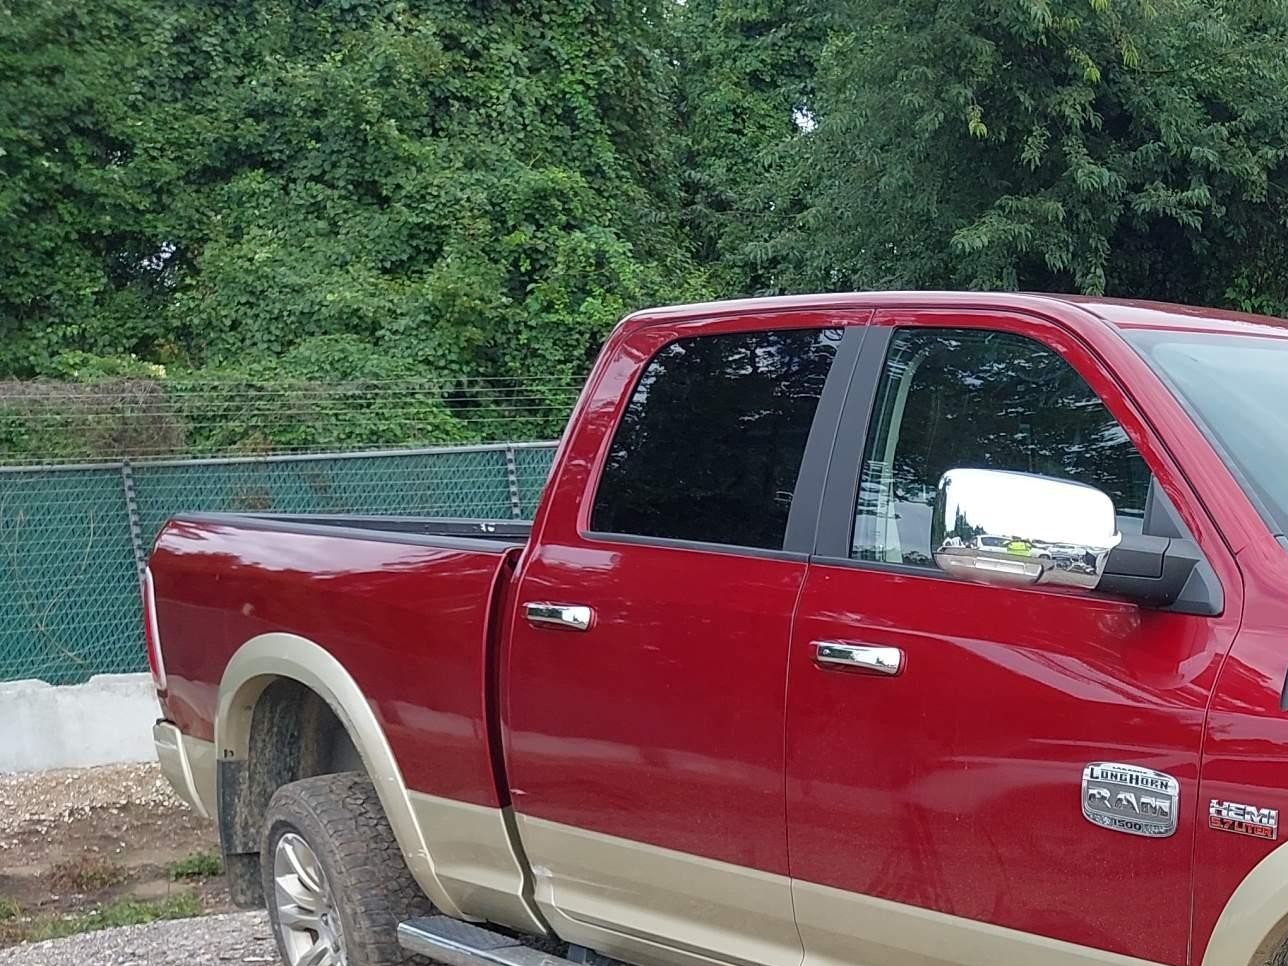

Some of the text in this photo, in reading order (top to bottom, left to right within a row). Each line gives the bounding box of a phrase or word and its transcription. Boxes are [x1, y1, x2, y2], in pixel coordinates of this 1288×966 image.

[1087, 787, 1171, 817] RAM
[1209, 799, 1278, 827] HEMI
[1114, 820, 1142, 832] 1500
